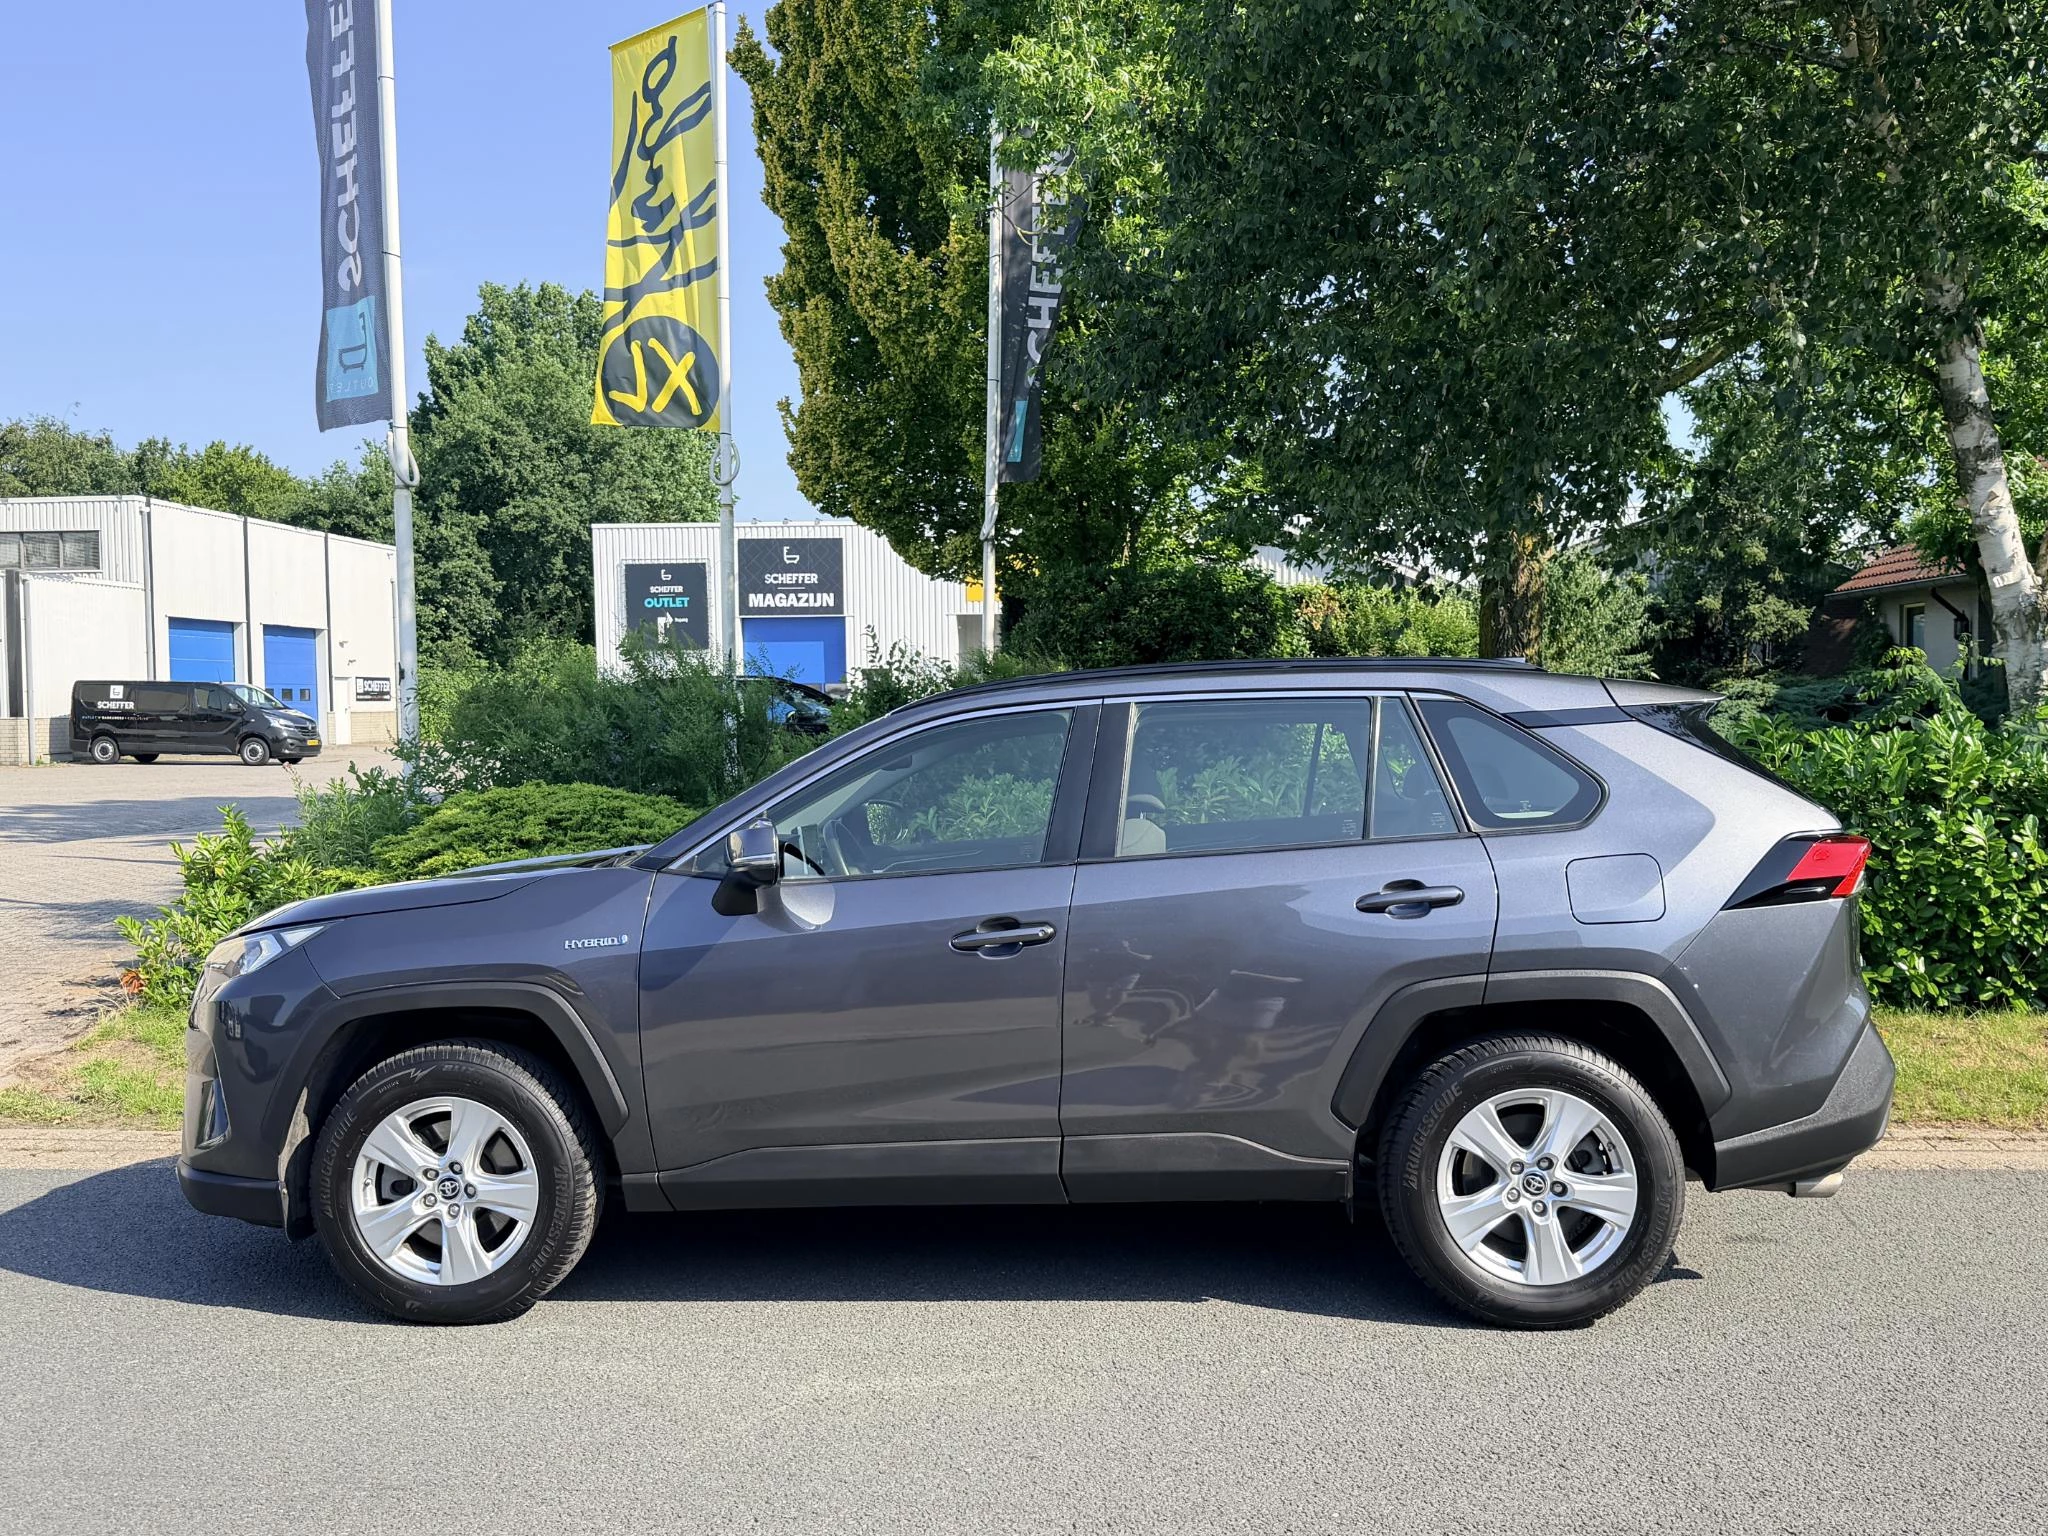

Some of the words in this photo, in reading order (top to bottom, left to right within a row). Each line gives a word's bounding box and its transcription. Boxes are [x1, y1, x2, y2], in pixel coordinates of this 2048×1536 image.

[764, 573, 819, 584] SCHEFFER
[649, 585, 684, 593] SCHEFFER
[644, 597, 690, 608] OUTLET
[748, 592, 835, 608] MAGAZIJN
[97, 701, 135, 709] SCHEFFER
[564, 936, 620, 949] HYBRID
[1402, 1081, 1463, 1190] BRIDGESTONE
